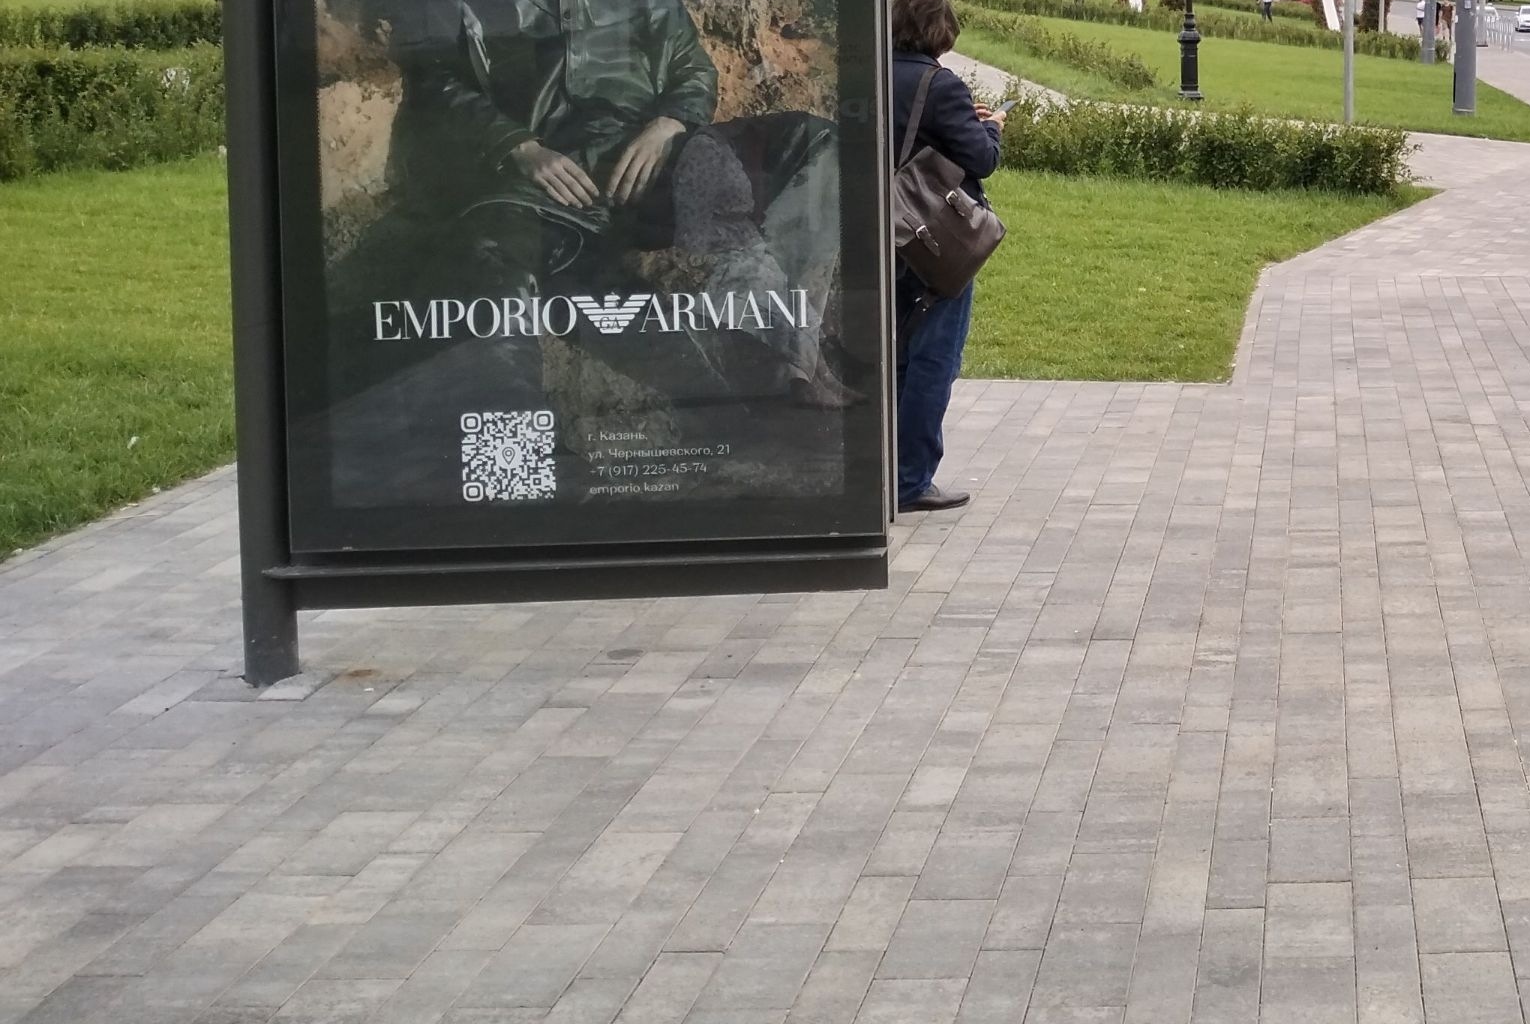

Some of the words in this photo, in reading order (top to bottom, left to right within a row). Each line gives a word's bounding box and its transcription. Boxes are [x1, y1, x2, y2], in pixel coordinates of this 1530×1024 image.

[372, 295, 578, 341] EMPORIO
[638, 289, 810, 333] ARMANI
[600, 432, 649, 442] Казань,
[587, 451, 605, 463] ул.
[608, 445, 714, 461] Чернышевского,
[717, 444, 731, 455] 21
[608, 465, 639, 478] (917)
[642, 462, 708, 476] 225-45-74
